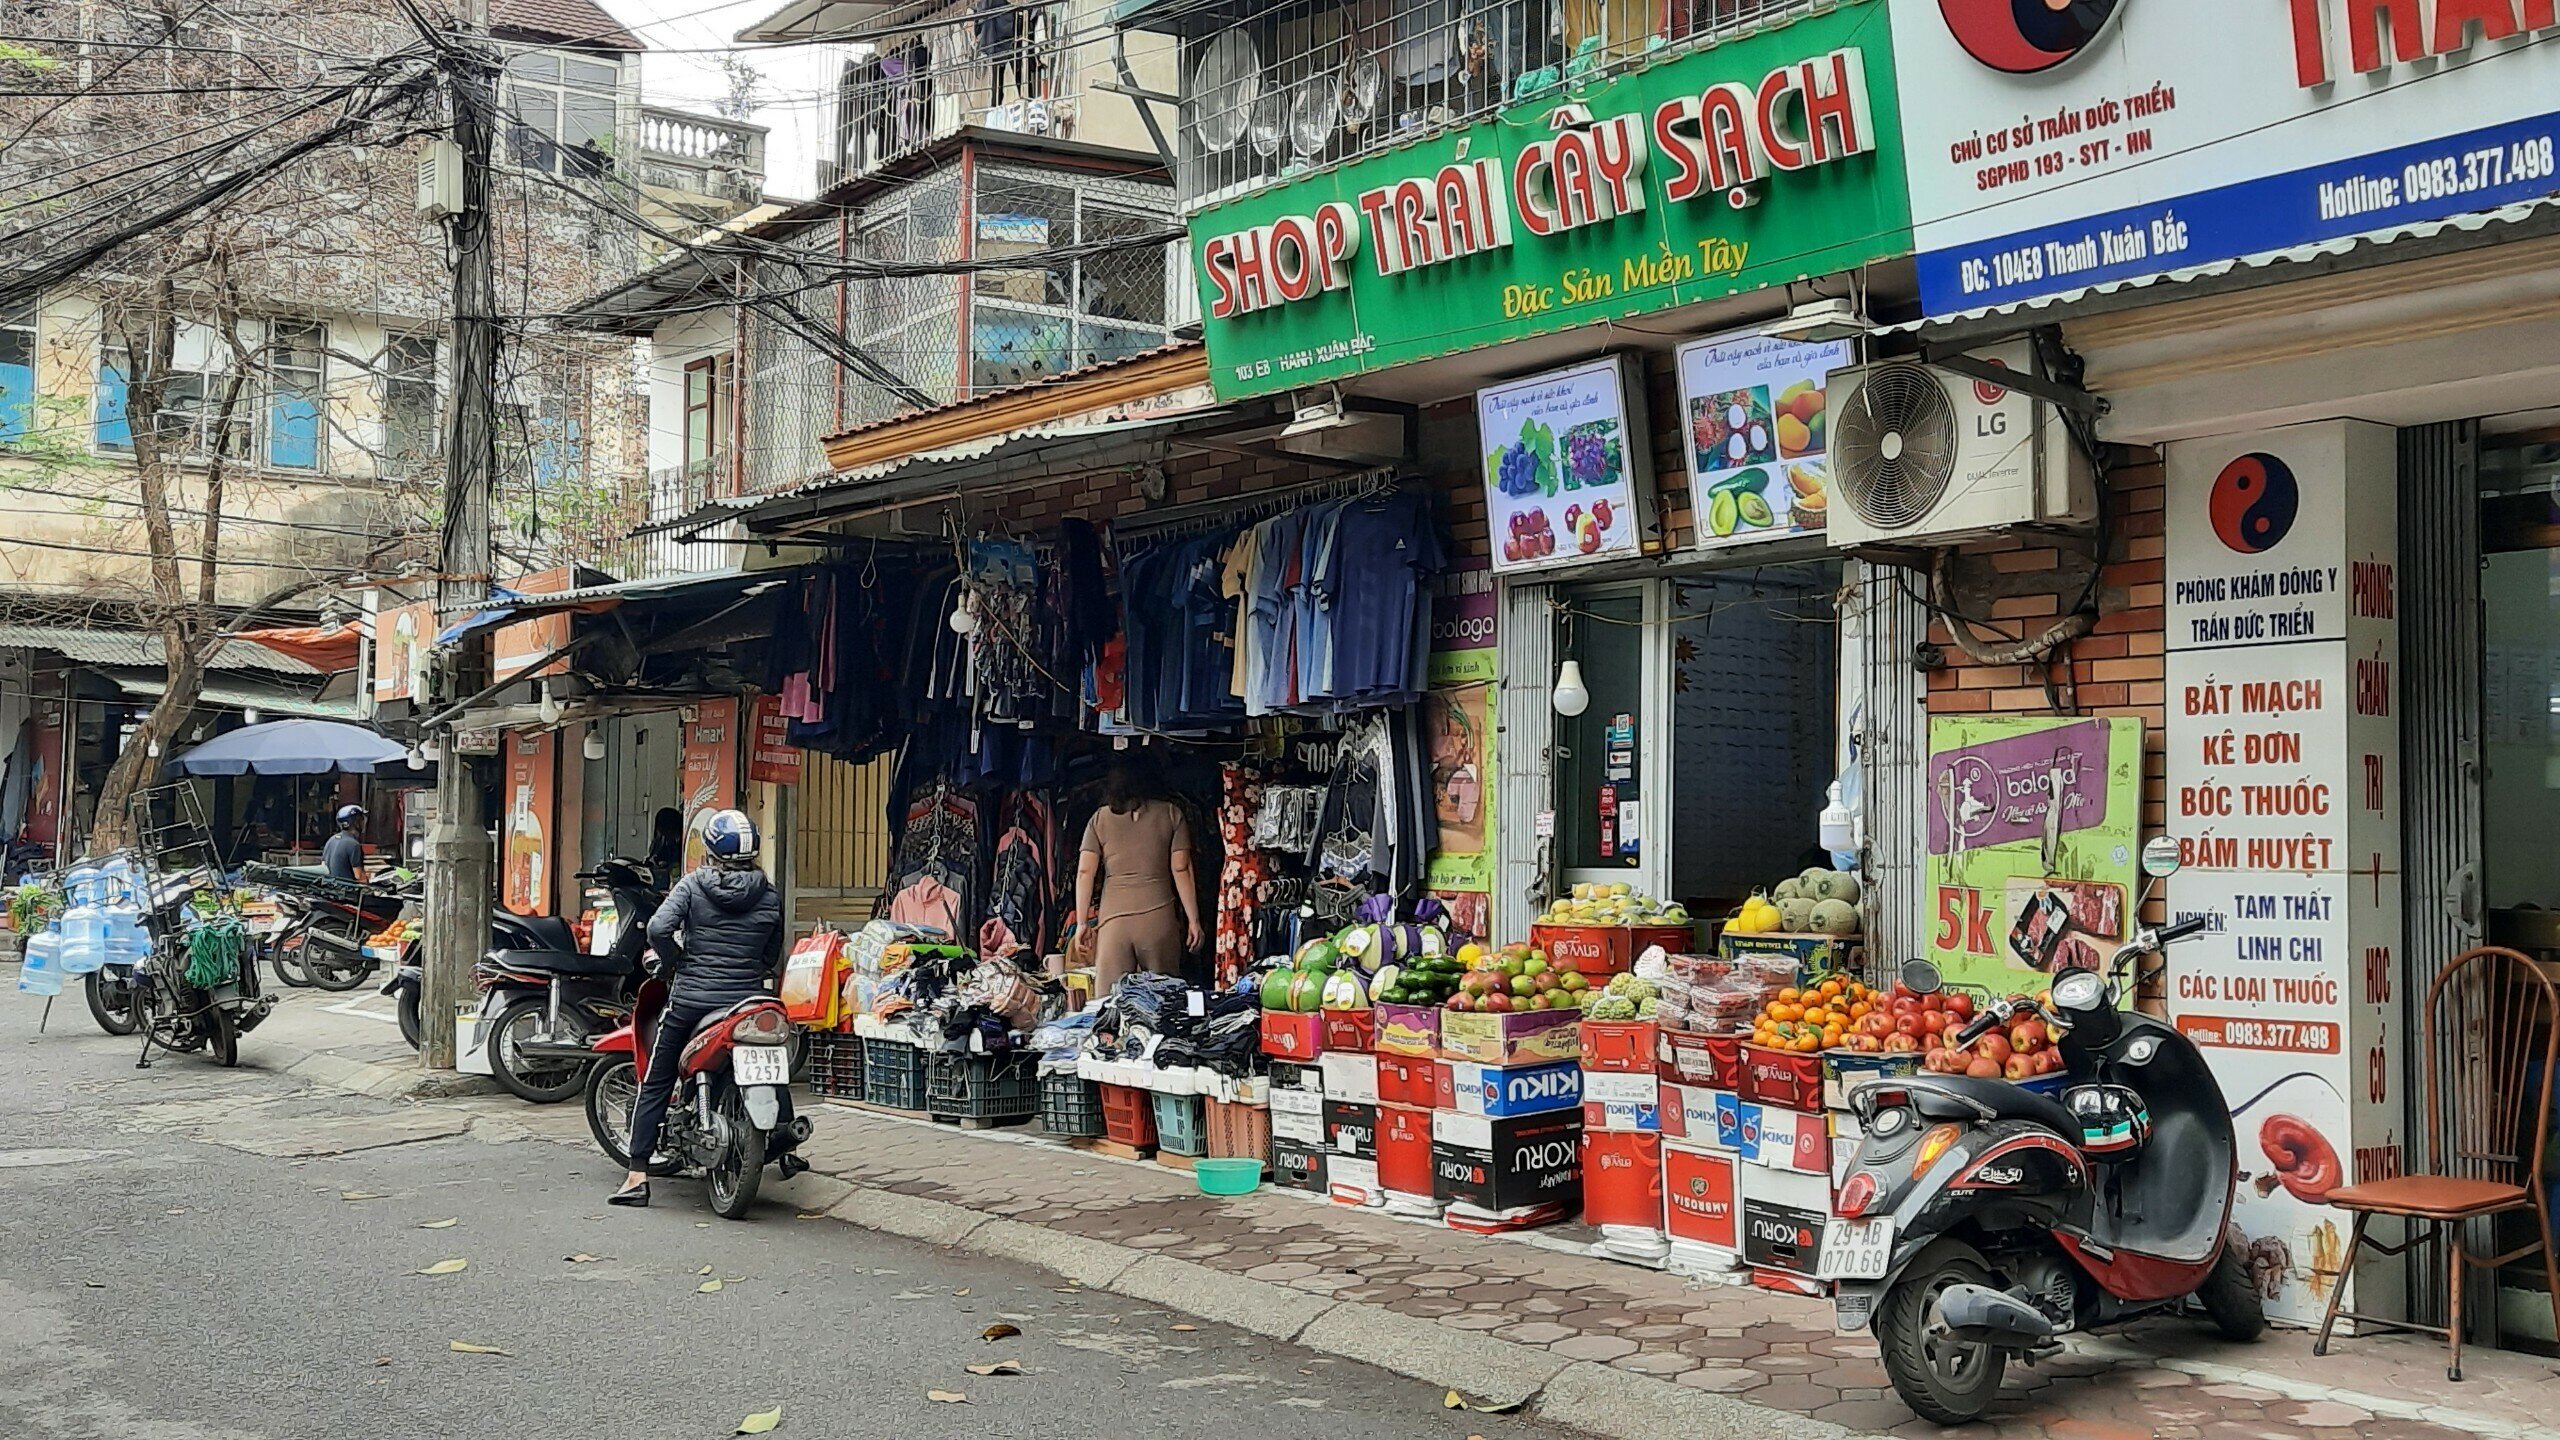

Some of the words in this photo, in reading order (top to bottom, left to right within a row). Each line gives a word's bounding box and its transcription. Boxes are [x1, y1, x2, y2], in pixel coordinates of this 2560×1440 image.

[1950, 130, 1982, 164] CHỦ
[1986, 128, 2007, 155] CƠ
[2011, 114, 2035, 148] SỞ
[2085, 97, 2120, 131] ĐỨC
[2123, 80, 2176, 121] TRIỂN
[1976, 159, 2030, 191] SGPHĐ
[2034, 151, 2064, 177] 193
[2079, 138, 2110, 167] SYT
[2126, 128, 2153, 155] HN
[2318, 169, 2400, 220] Hotline:
[2404, 135, 2555, 204] 0983.377.498
[1204, 201, 1354, 319] SHOP
[1360, 137, 1508, 277] TRÁI
[1514, 104, 1644, 236] CÂY
[1653, 47, 1873, 211] SẠCH
[1961, 259, 1990, 294] ĐC:
[1992, 243, 2042, 286] 104E8
[2044, 231, 2098, 276] Thanh
[2101, 224, 2146, 266] Xuân
[2152, 209, 2189, 255] Bắc
[1502, 277, 1553, 318] Đặc
[1561, 262, 1613, 306] Sản
[1697, 236, 1749, 281] Tây
[1235, 364, 1253, 381] 103
[1255, 359, 1271, 377] E8
[1315, 339, 1350, 364] XUÂN
[1977, 412, 2006, 437] LG
[2176, 575, 2225, 605] PHÒNG
[2230, 569, 2275, 600] KHÁM
[2279, 566, 2323, 595] ĐÔNG
[2328, 567, 2338, 592] Y
[2352, 552, 2394, 620] PHÒNG
[1433, 613, 1494, 642] bologa
[2234, 609, 2264, 639] ĐỨC
[2269, 602, 2314, 637] TRIỂN
[2184, 673, 2233, 716] BẮT
[2242, 678, 2322, 718] MẠCH
[2356, 638, 2390, 717] CHẨN
[2203, 728, 2235, 766] KÊ
[2244, 731, 2301, 764] ĐƠN
[2006, 768, 2076, 797] boloa
[2180, 776, 2232, 817] BỐC
[2241, 775, 2330, 816] THUỐC
[2364, 754, 2384, 820] TRỊ
[2180, 827, 2238, 868] BẤM
[2247, 832, 2333, 879] HUYỆT
[2372, 852, 2382, 909] Y
[2234, 894, 2277, 921] TAM
[2282, 888, 2332, 921] THẤT
[2237, 936, 2283, 961] LINH
[2288, 936, 2323, 963] CHI
[2179, 970, 2217, 1000] CÁC
[2223, 976, 2267, 1008] LOẠI
[2273, 970, 2338, 1005] THUỐC
[2364, 946, 2392, 1016] HỌC
[2186, 1026, 2223, 1044] Hotline:
[2224, 1020, 2331, 1050] 0983.377.498
[2369, 1022, 2386, 1104] CỔ
[1456, 1082, 1481, 1096] KIKU
[1508, 1070, 1579, 1102] KIKU
[1606, 1104, 1634, 1117] KIKU
[1685, 1107, 1716, 1122] KIKU
[1514, 1139, 1576, 1172] KORU
[1762, 1129, 1794, 1146] KIKU
[1278, 1151, 1308, 1170] KORU
[1439, 1160, 1473, 1180] KORU
[1673, 1192, 1728, 1213] AMBROSIA
[1753, 1219, 1798, 1246] KORU
[1832, 1221, 1883, 1246] 29-AB
[1823, 1250, 1884, 1274] 070.68
